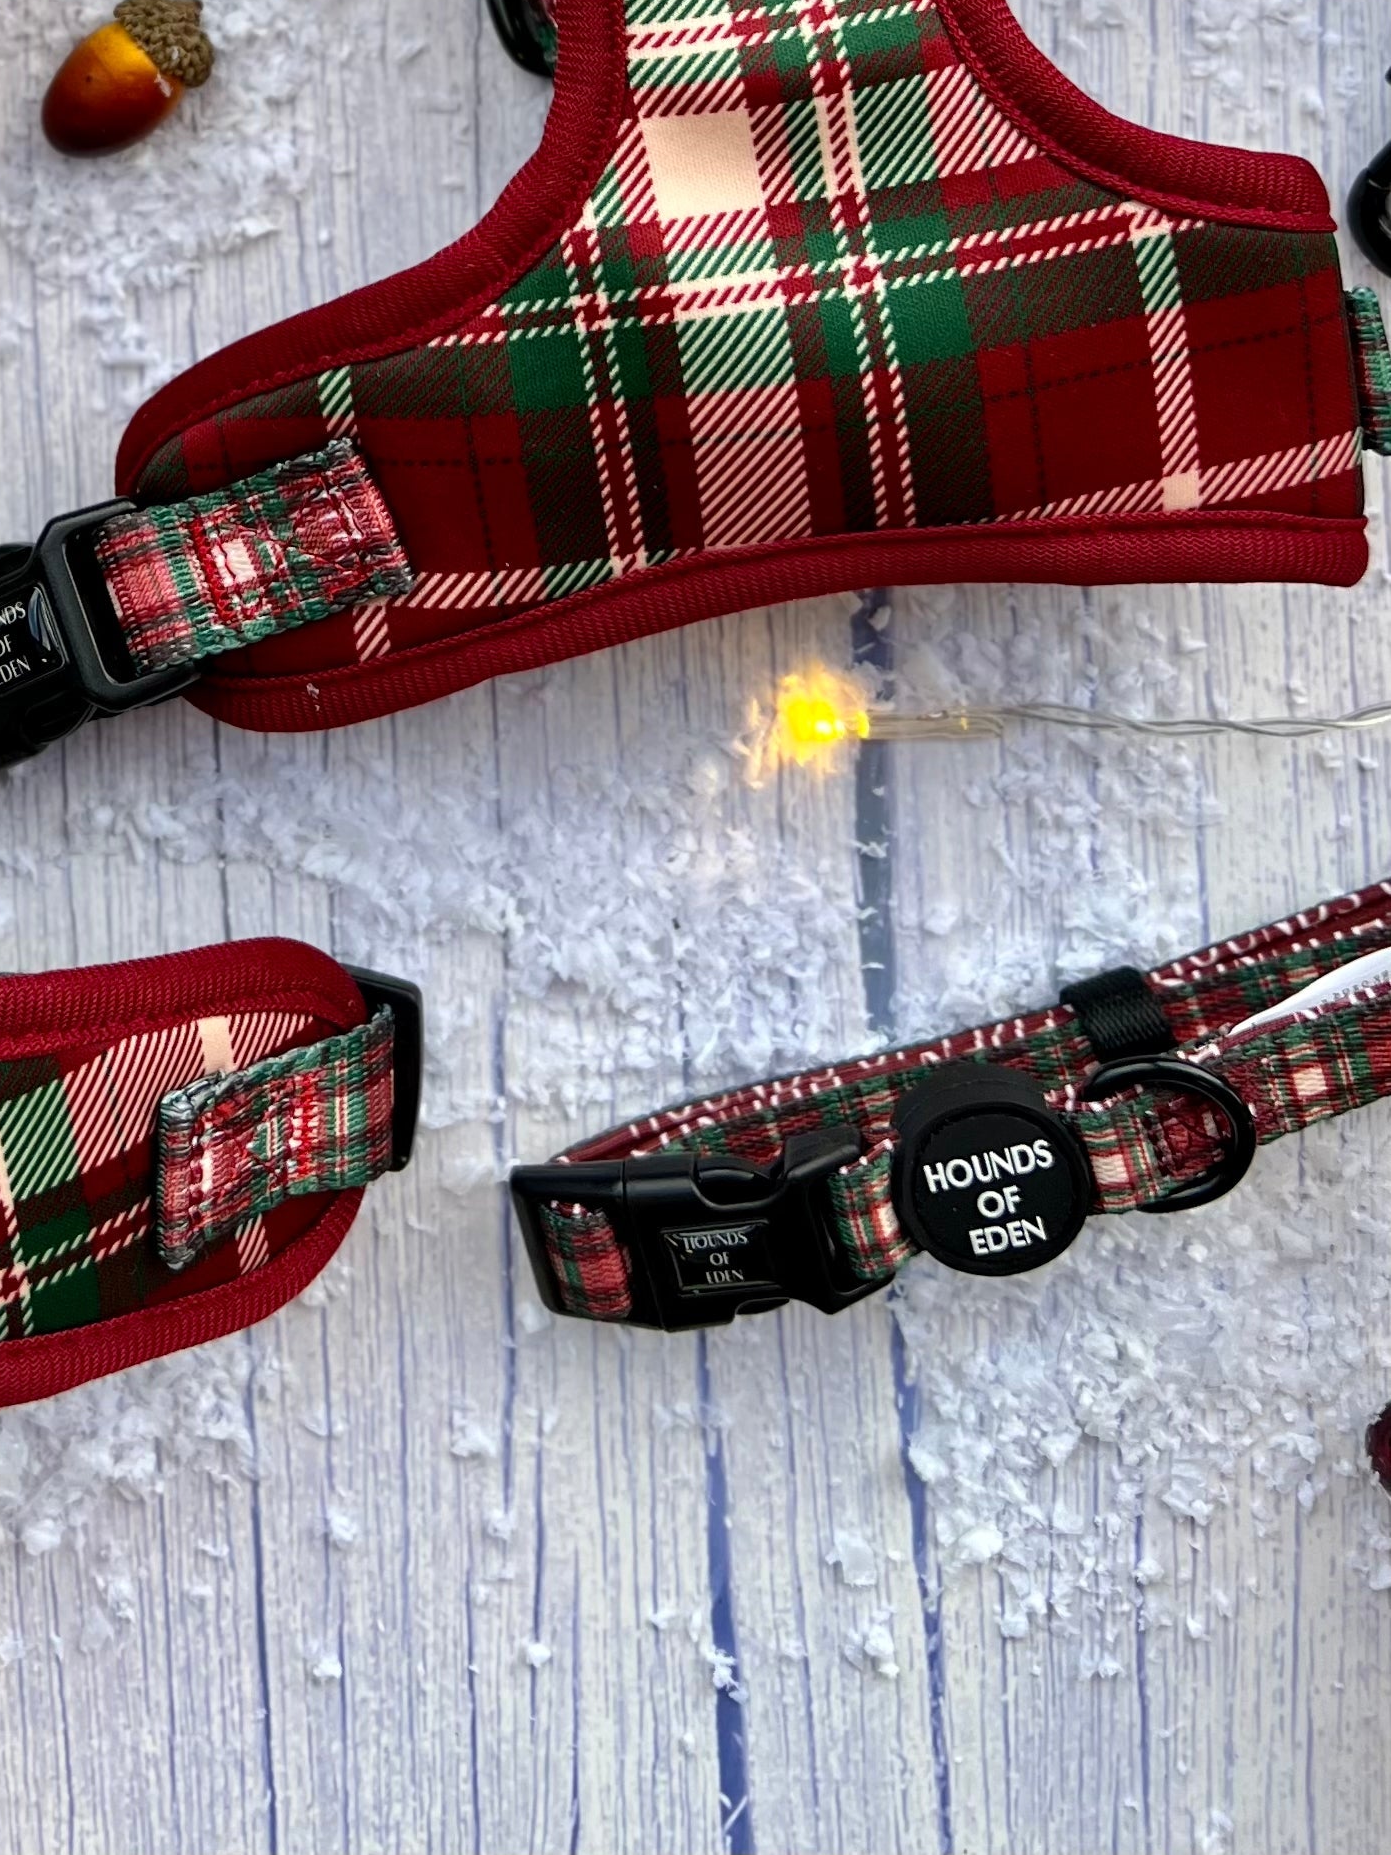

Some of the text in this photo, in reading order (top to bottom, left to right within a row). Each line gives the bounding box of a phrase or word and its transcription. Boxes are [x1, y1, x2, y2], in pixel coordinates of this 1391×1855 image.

[923, 1139, 1054, 1193] HOUNDS
[977, 1185, 1021, 1219] OF
[683, 1231, 748, 1253] HOUNDS
[969, 1216, 1047, 1256] EDEN
[709, 1252, 730, 1266] OF
[706, 1270, 744, 1284] EDEN
